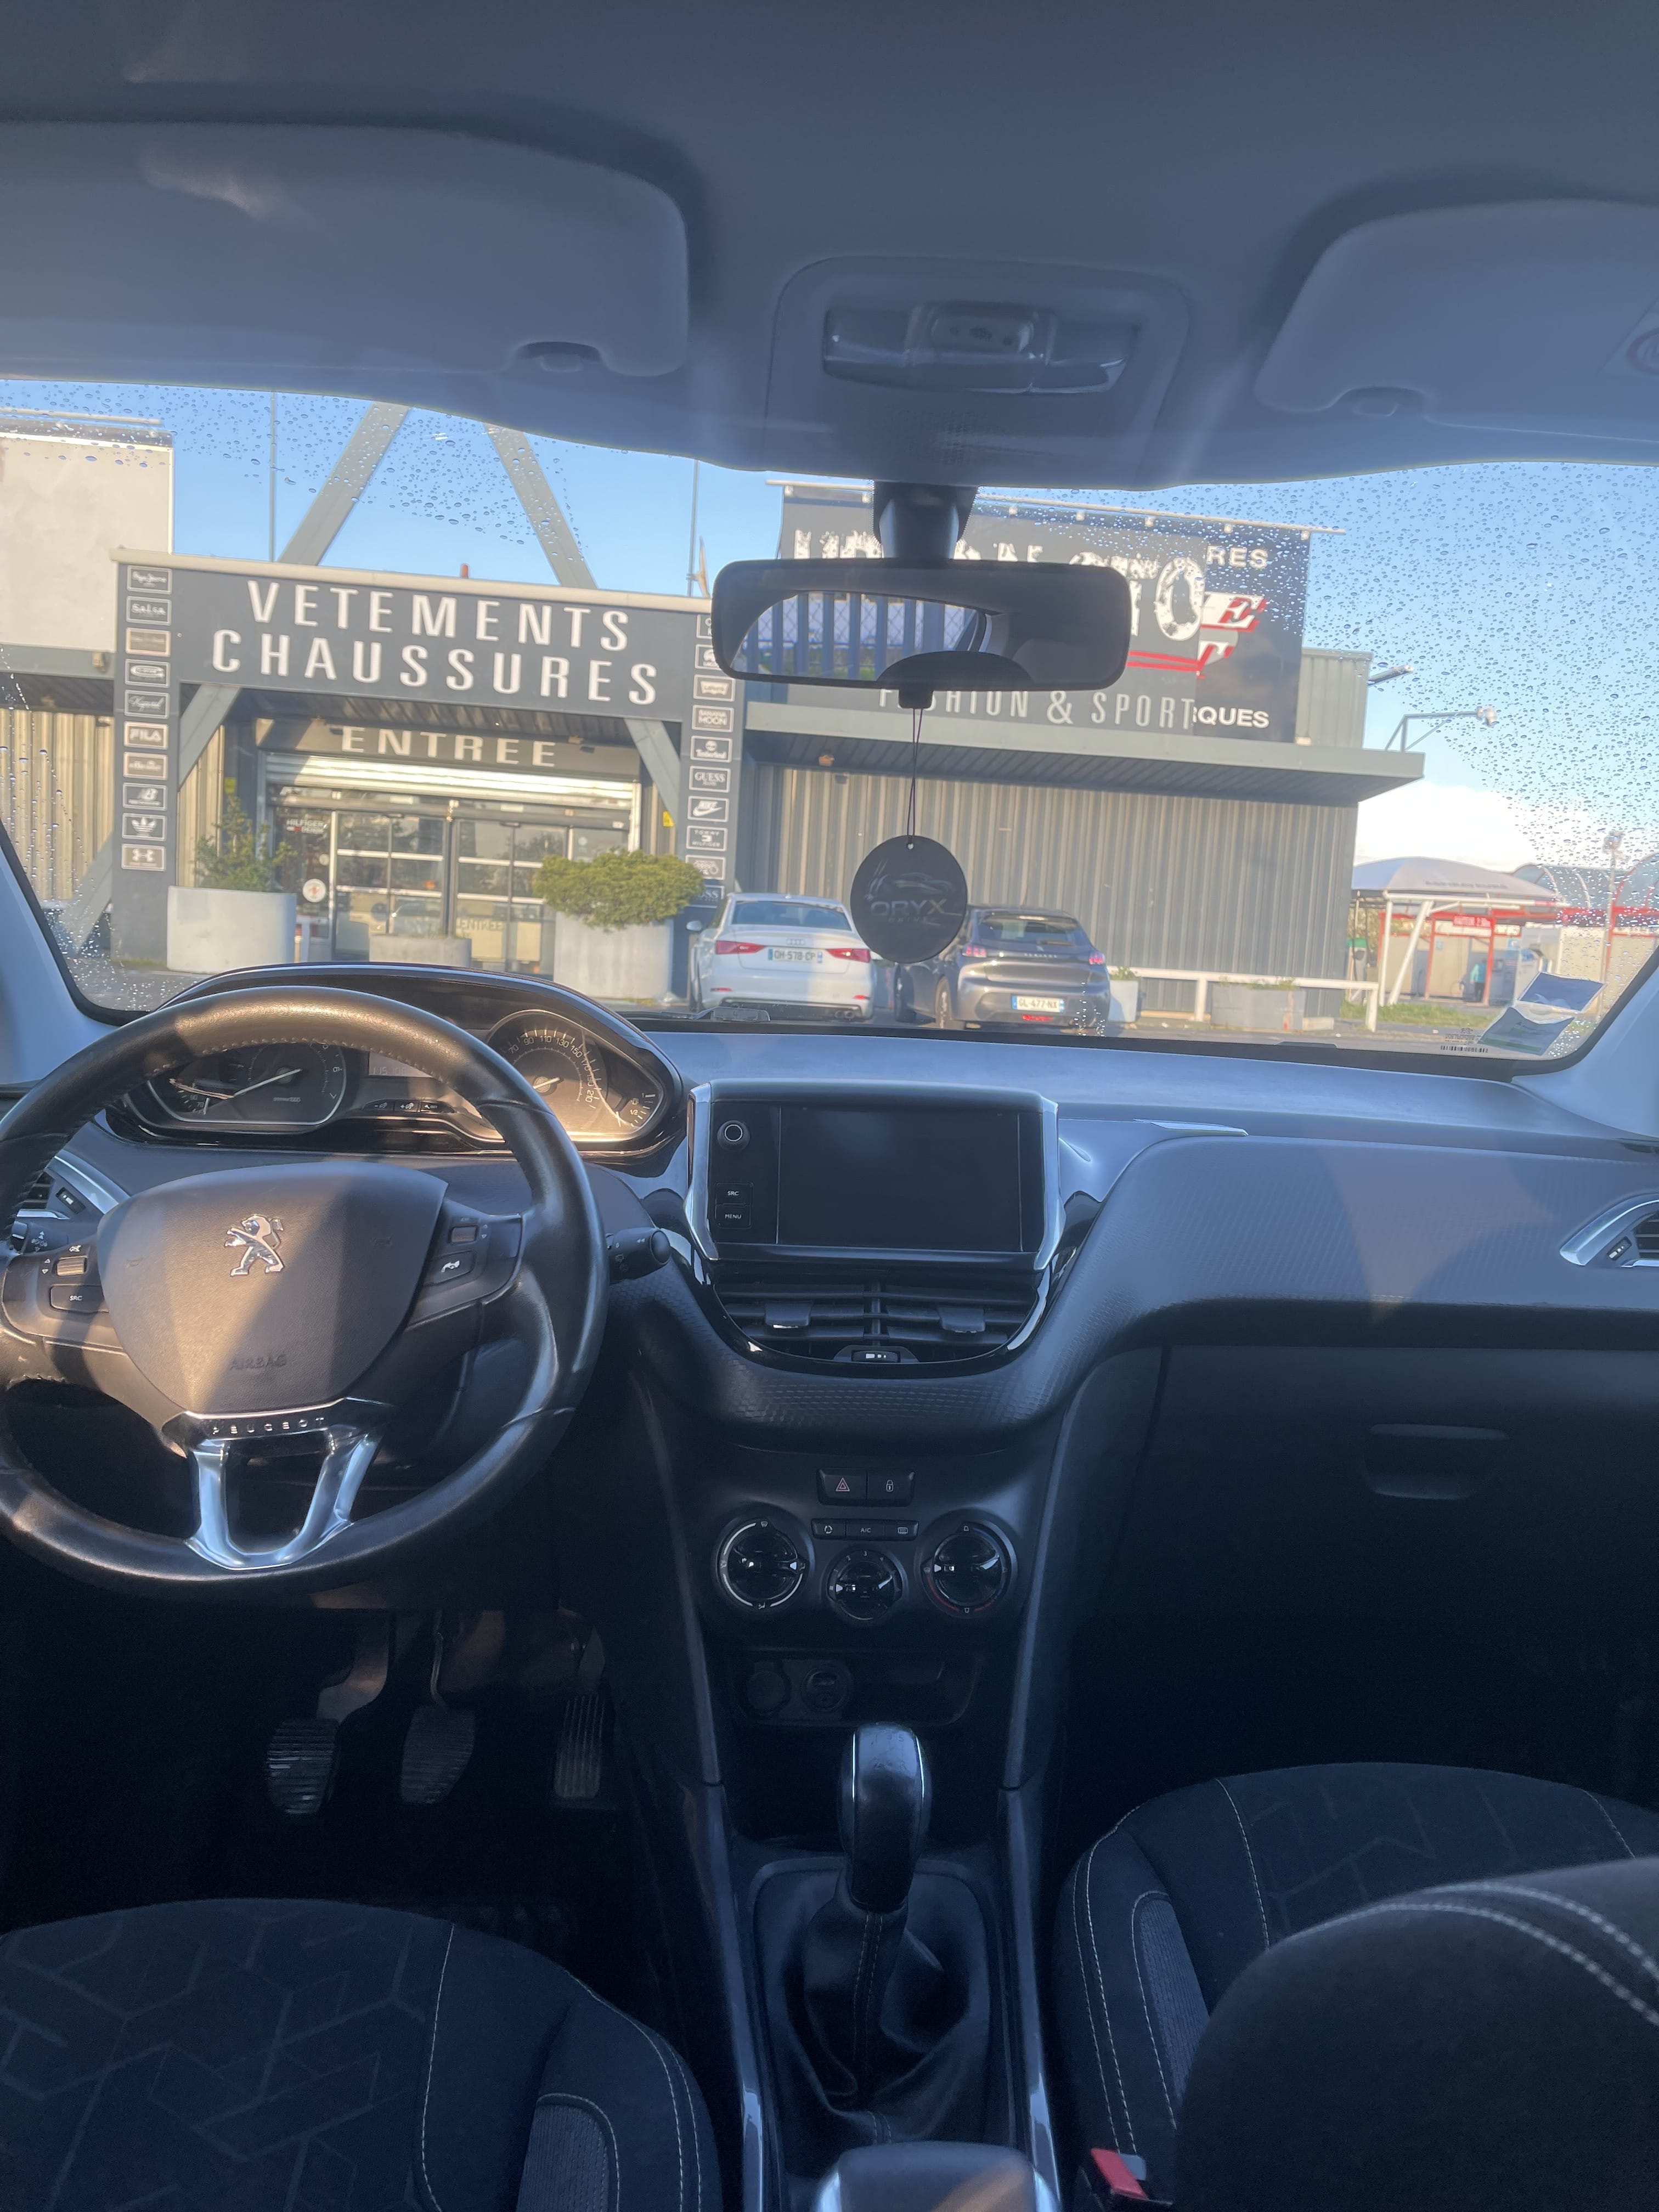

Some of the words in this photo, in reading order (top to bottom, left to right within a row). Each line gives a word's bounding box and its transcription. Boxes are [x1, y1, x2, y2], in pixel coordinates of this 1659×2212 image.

[131, 603, 166, 615] Salsa
[247, 580, 629, 652] VETEMENTS
[212, 629, 657, 706] CHAUSSURES
[879, 689, 1028, 718] FHION
[1047, 690, 1073, 725] &
[1092, 692, 1194, 730] SPORT
[698, 716, 727, 725] MOON
[130, 728, 161, 742] FILA
[341, 725, 556, 767] ENTREE
[695, 771, 725, 783] GUESS
[870, 899, 947, 916] ORYX
[523, 1037, 534, 1046] 90
[556, 1037, 569, 1049] 130
[509, 1045, 519, 1053] 70
[570, 1045, 583, 1058] 150
[585, 1090, 595, 1103] 210
